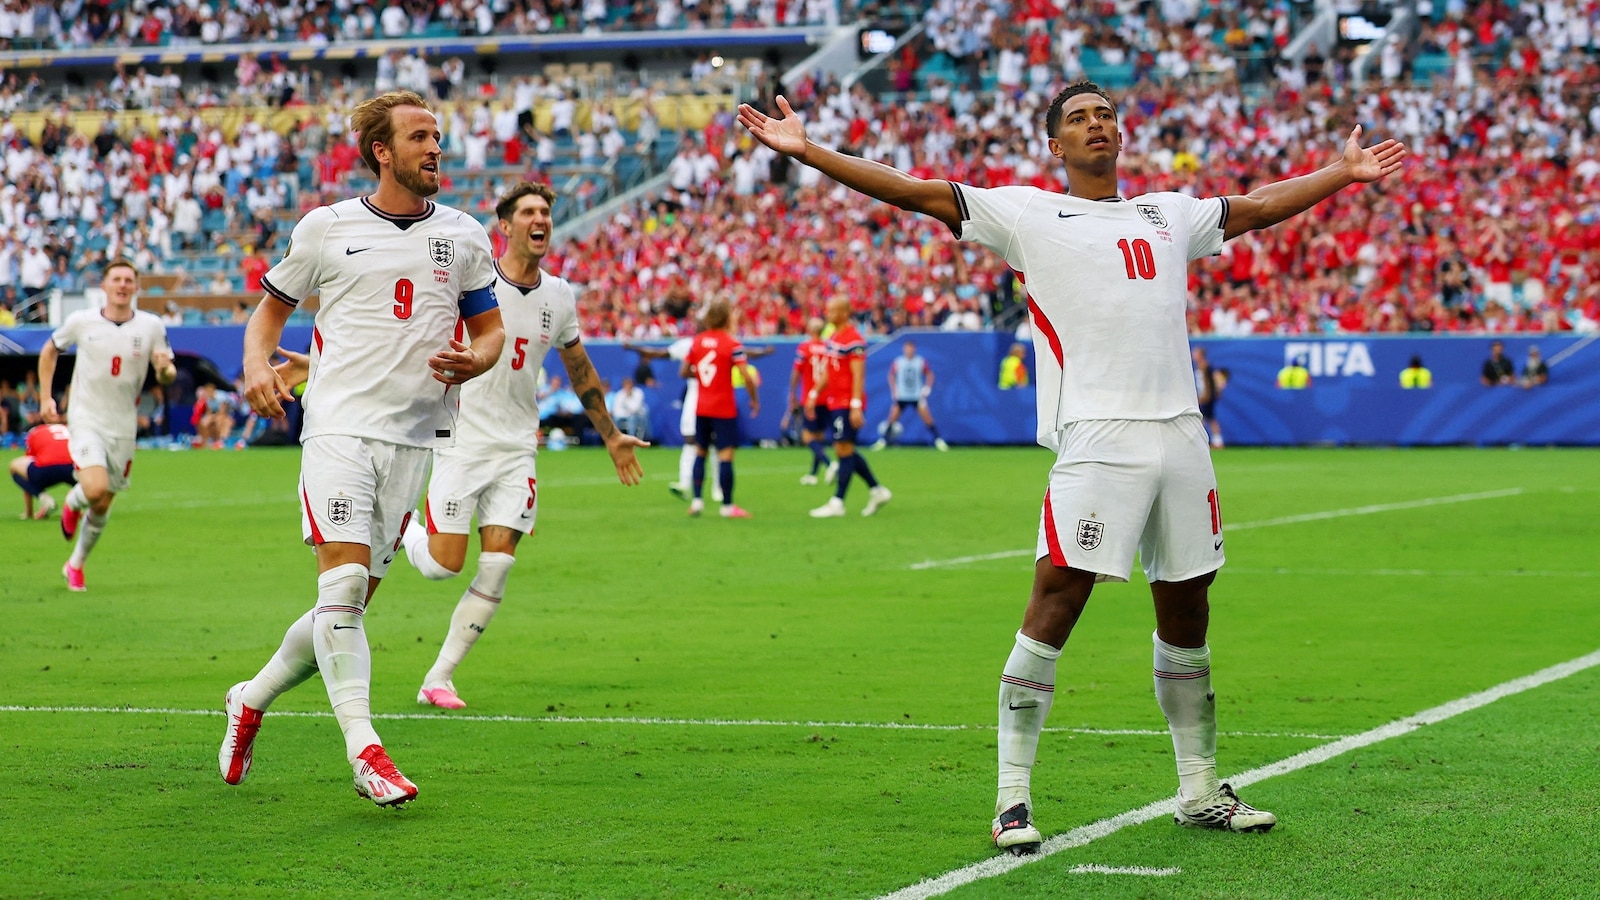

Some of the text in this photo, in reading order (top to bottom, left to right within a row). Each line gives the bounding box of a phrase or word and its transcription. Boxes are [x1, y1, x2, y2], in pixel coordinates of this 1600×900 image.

[1117, 238, 1157, 280] 10
[393, 278, 414, 320] 9
[111, 355, 122, 377] 8
[511, 336, 529, 371] 5
[697, 349, 717, 388] 6
[1284, 341, 1376, 377] FIFA
[527, 477, 536, 510] 5
